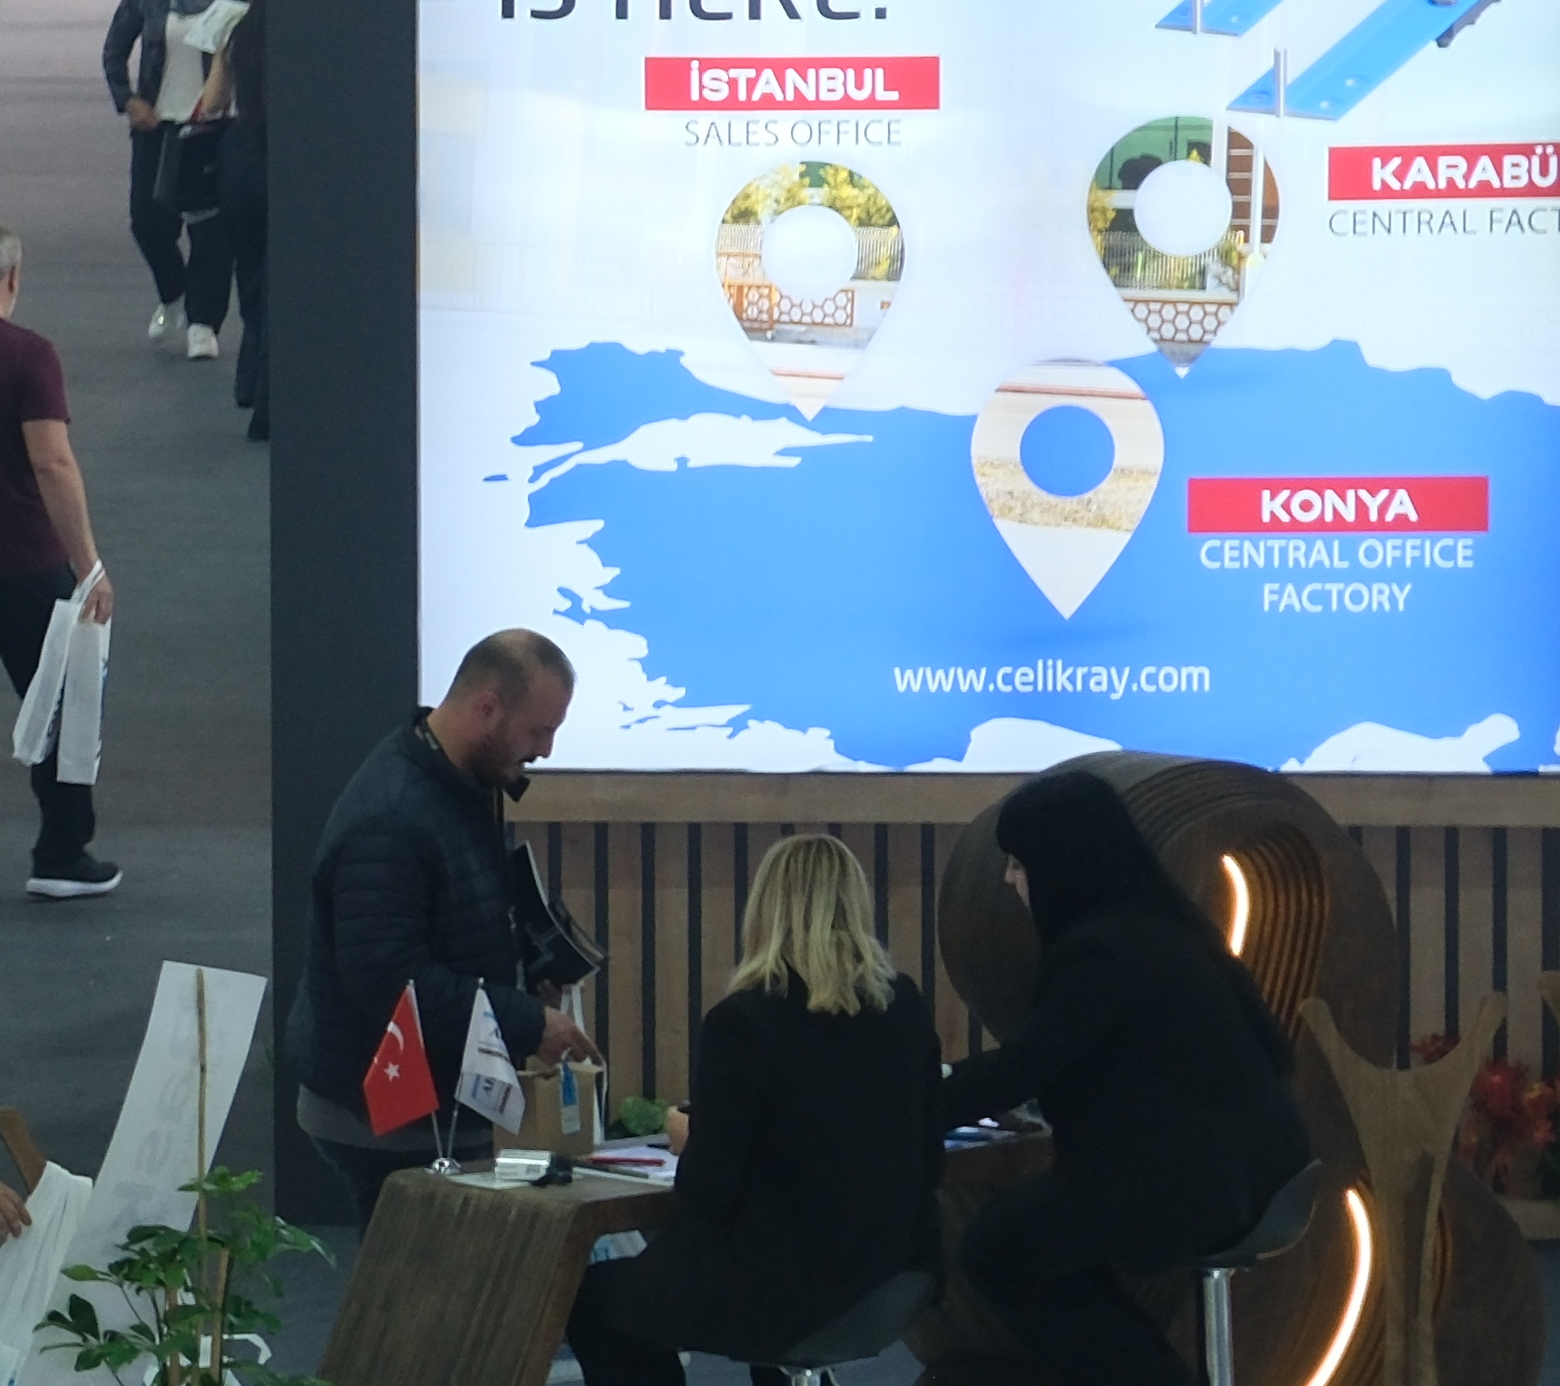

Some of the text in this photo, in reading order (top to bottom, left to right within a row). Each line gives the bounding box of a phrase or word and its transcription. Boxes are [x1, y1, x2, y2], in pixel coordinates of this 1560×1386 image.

[690, 60, 899, 101] İSTANBUL
[685, 120, 902, 146] SALES OFFICE
[1372, 145, 1558, 191] KARABÜ
[1329, 208, 1477, 237] CENTRAL
[1261, 489, 1419, 522] KONYA
[1200, 539, 1474, 569] CENTRAL OFFICE
[1263, 583, 1412, 613] FACTORY
[894, 660, 1210, 700] www.celikray.com
